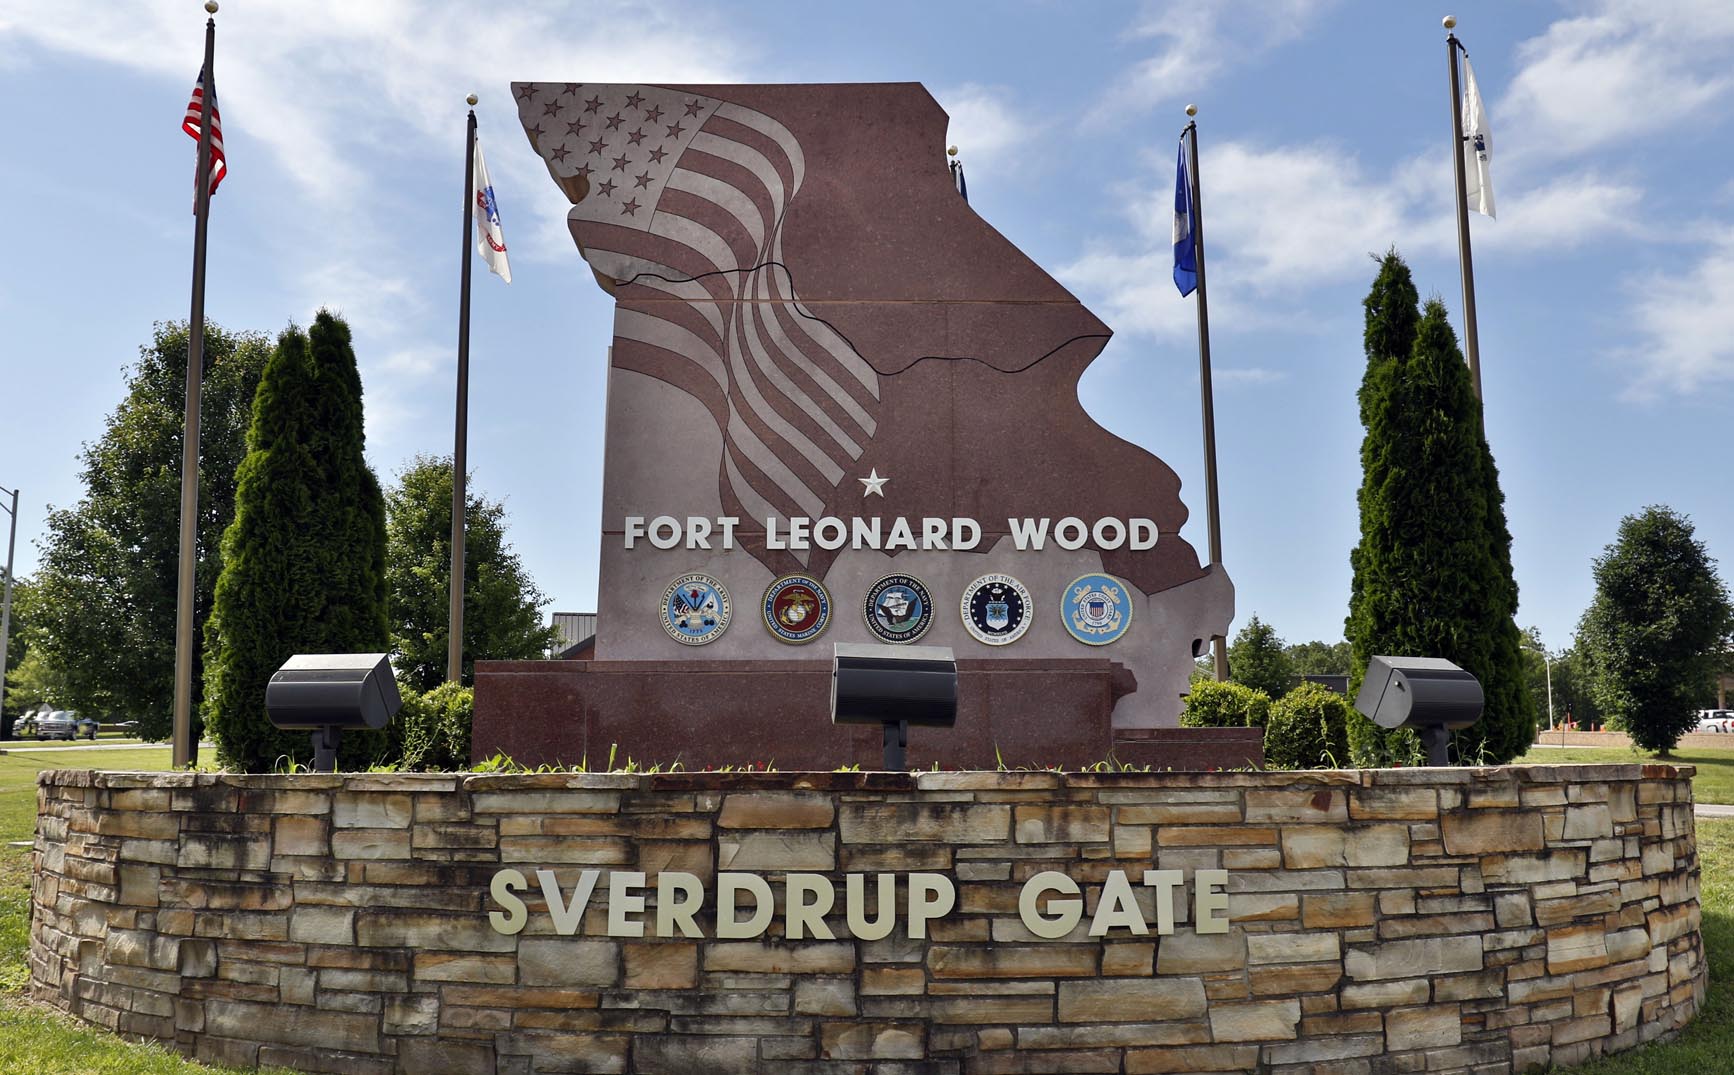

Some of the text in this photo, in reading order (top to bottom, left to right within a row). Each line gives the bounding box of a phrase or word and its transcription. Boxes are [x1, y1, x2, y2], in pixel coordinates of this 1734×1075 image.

[624, 516, 1159, 551] FORT LEONARD WOOD
[662, 576, 693, 605] DEPARTMENT
[706, 577, 717, 588] THE
[717, 586, 728, 603] ARMY
[768, 578, 801, 602] DEPARTMENT
[816, 589, 827, 604] NAVY
[868, 578, 898, 607] DEPARTMENT
[909, 580, 920, 590] THE
[919, 590, 929, 606] NAVY
[963, 576, 987, 621] DEPARTMENT
[1000, 575, 1014, 586] THE
[1014, 583, 1026, 595] AIR
[1023, 594, 1032, 619] FORCE
[662, 612, 677, 634] UNITED
[676, 631, 700, 642] STATES
[710, 611, 729, 637] AMERICA
[767, 610, 827, 638] UNITED STATES MARINE CORPS
[868, 613, 883, 633] UNITED
[883, 630, 903, 639] STATES
[911, 613, 929, 636] AMERICA
[488, 868, 1230, 941] SVERDRUP GATE
